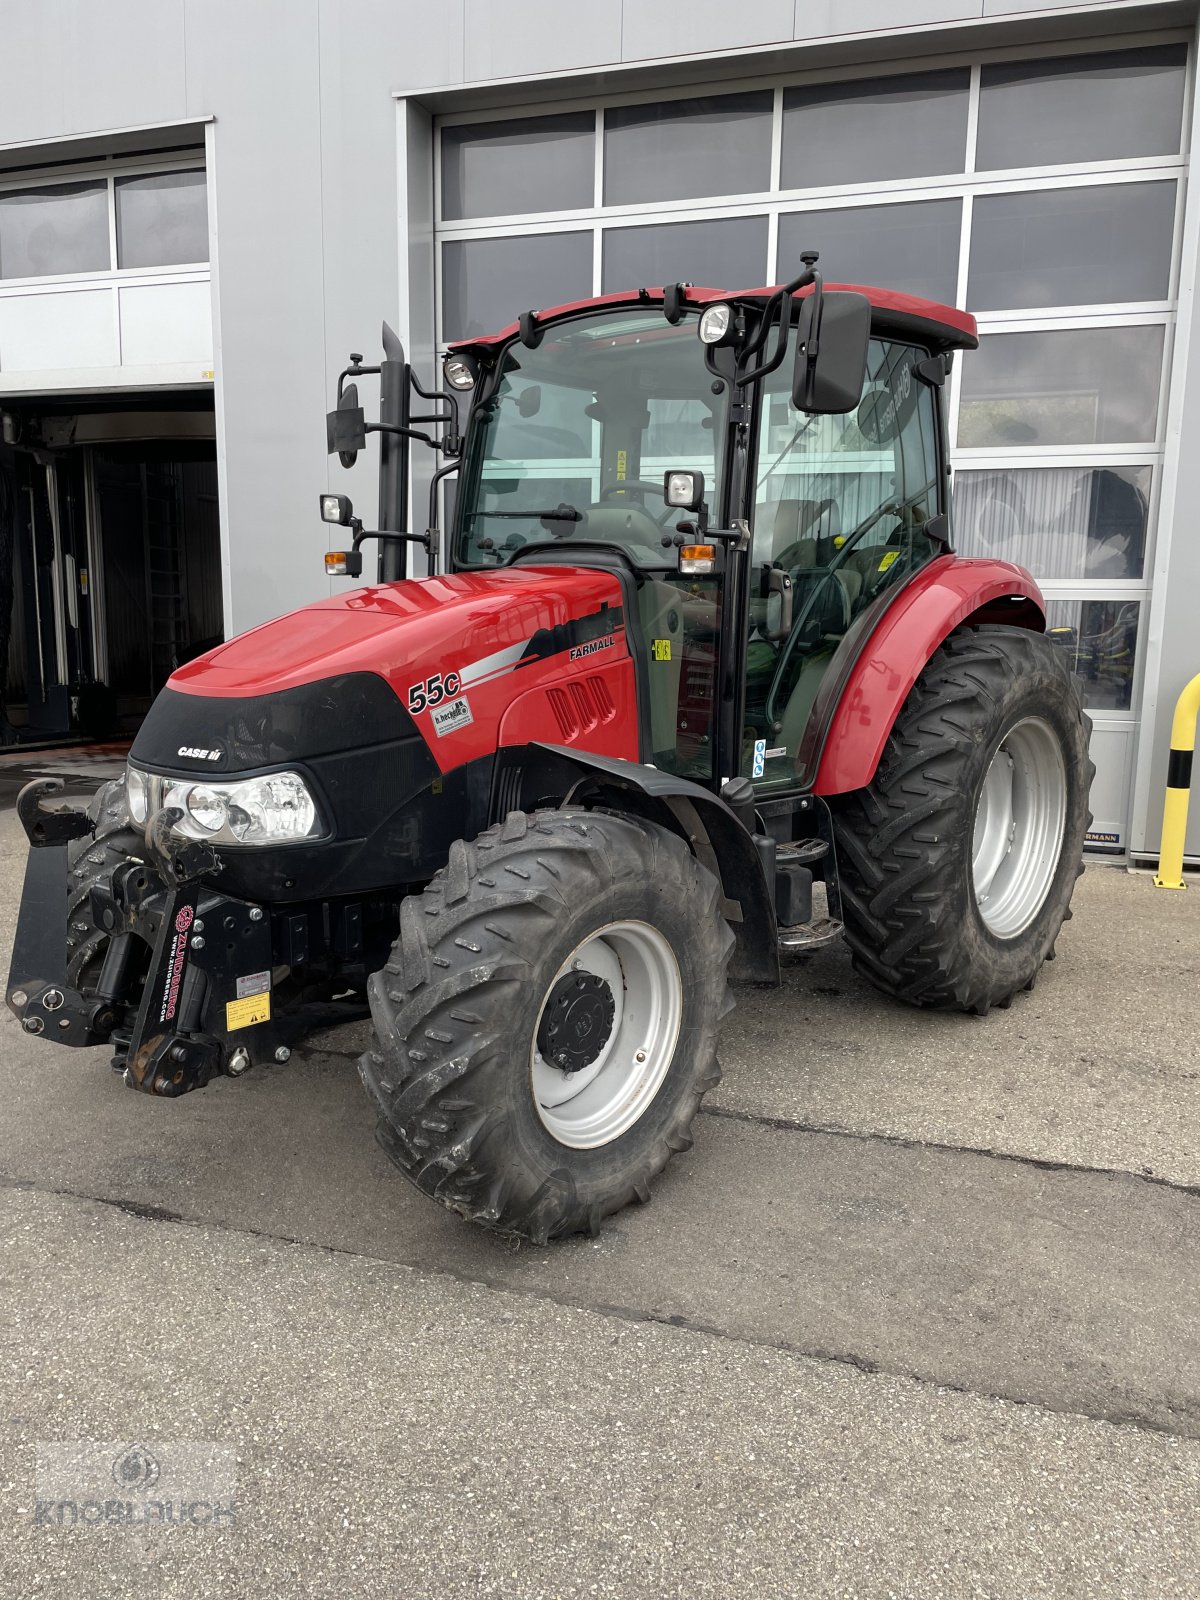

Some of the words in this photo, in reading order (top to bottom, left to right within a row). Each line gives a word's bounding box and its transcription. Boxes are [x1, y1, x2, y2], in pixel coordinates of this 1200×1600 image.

[570, 636, 615, 661] FARMALL
[408, 672, 460, 715] 55C
[178, 746, 209, 758] CASE
[1086, 833, 1117, 841] RMANN
[160, 934, 178, 1022] WWW.ZUIDBERG.COM
[166, 931, 188, 1020] ZUIDBERG
